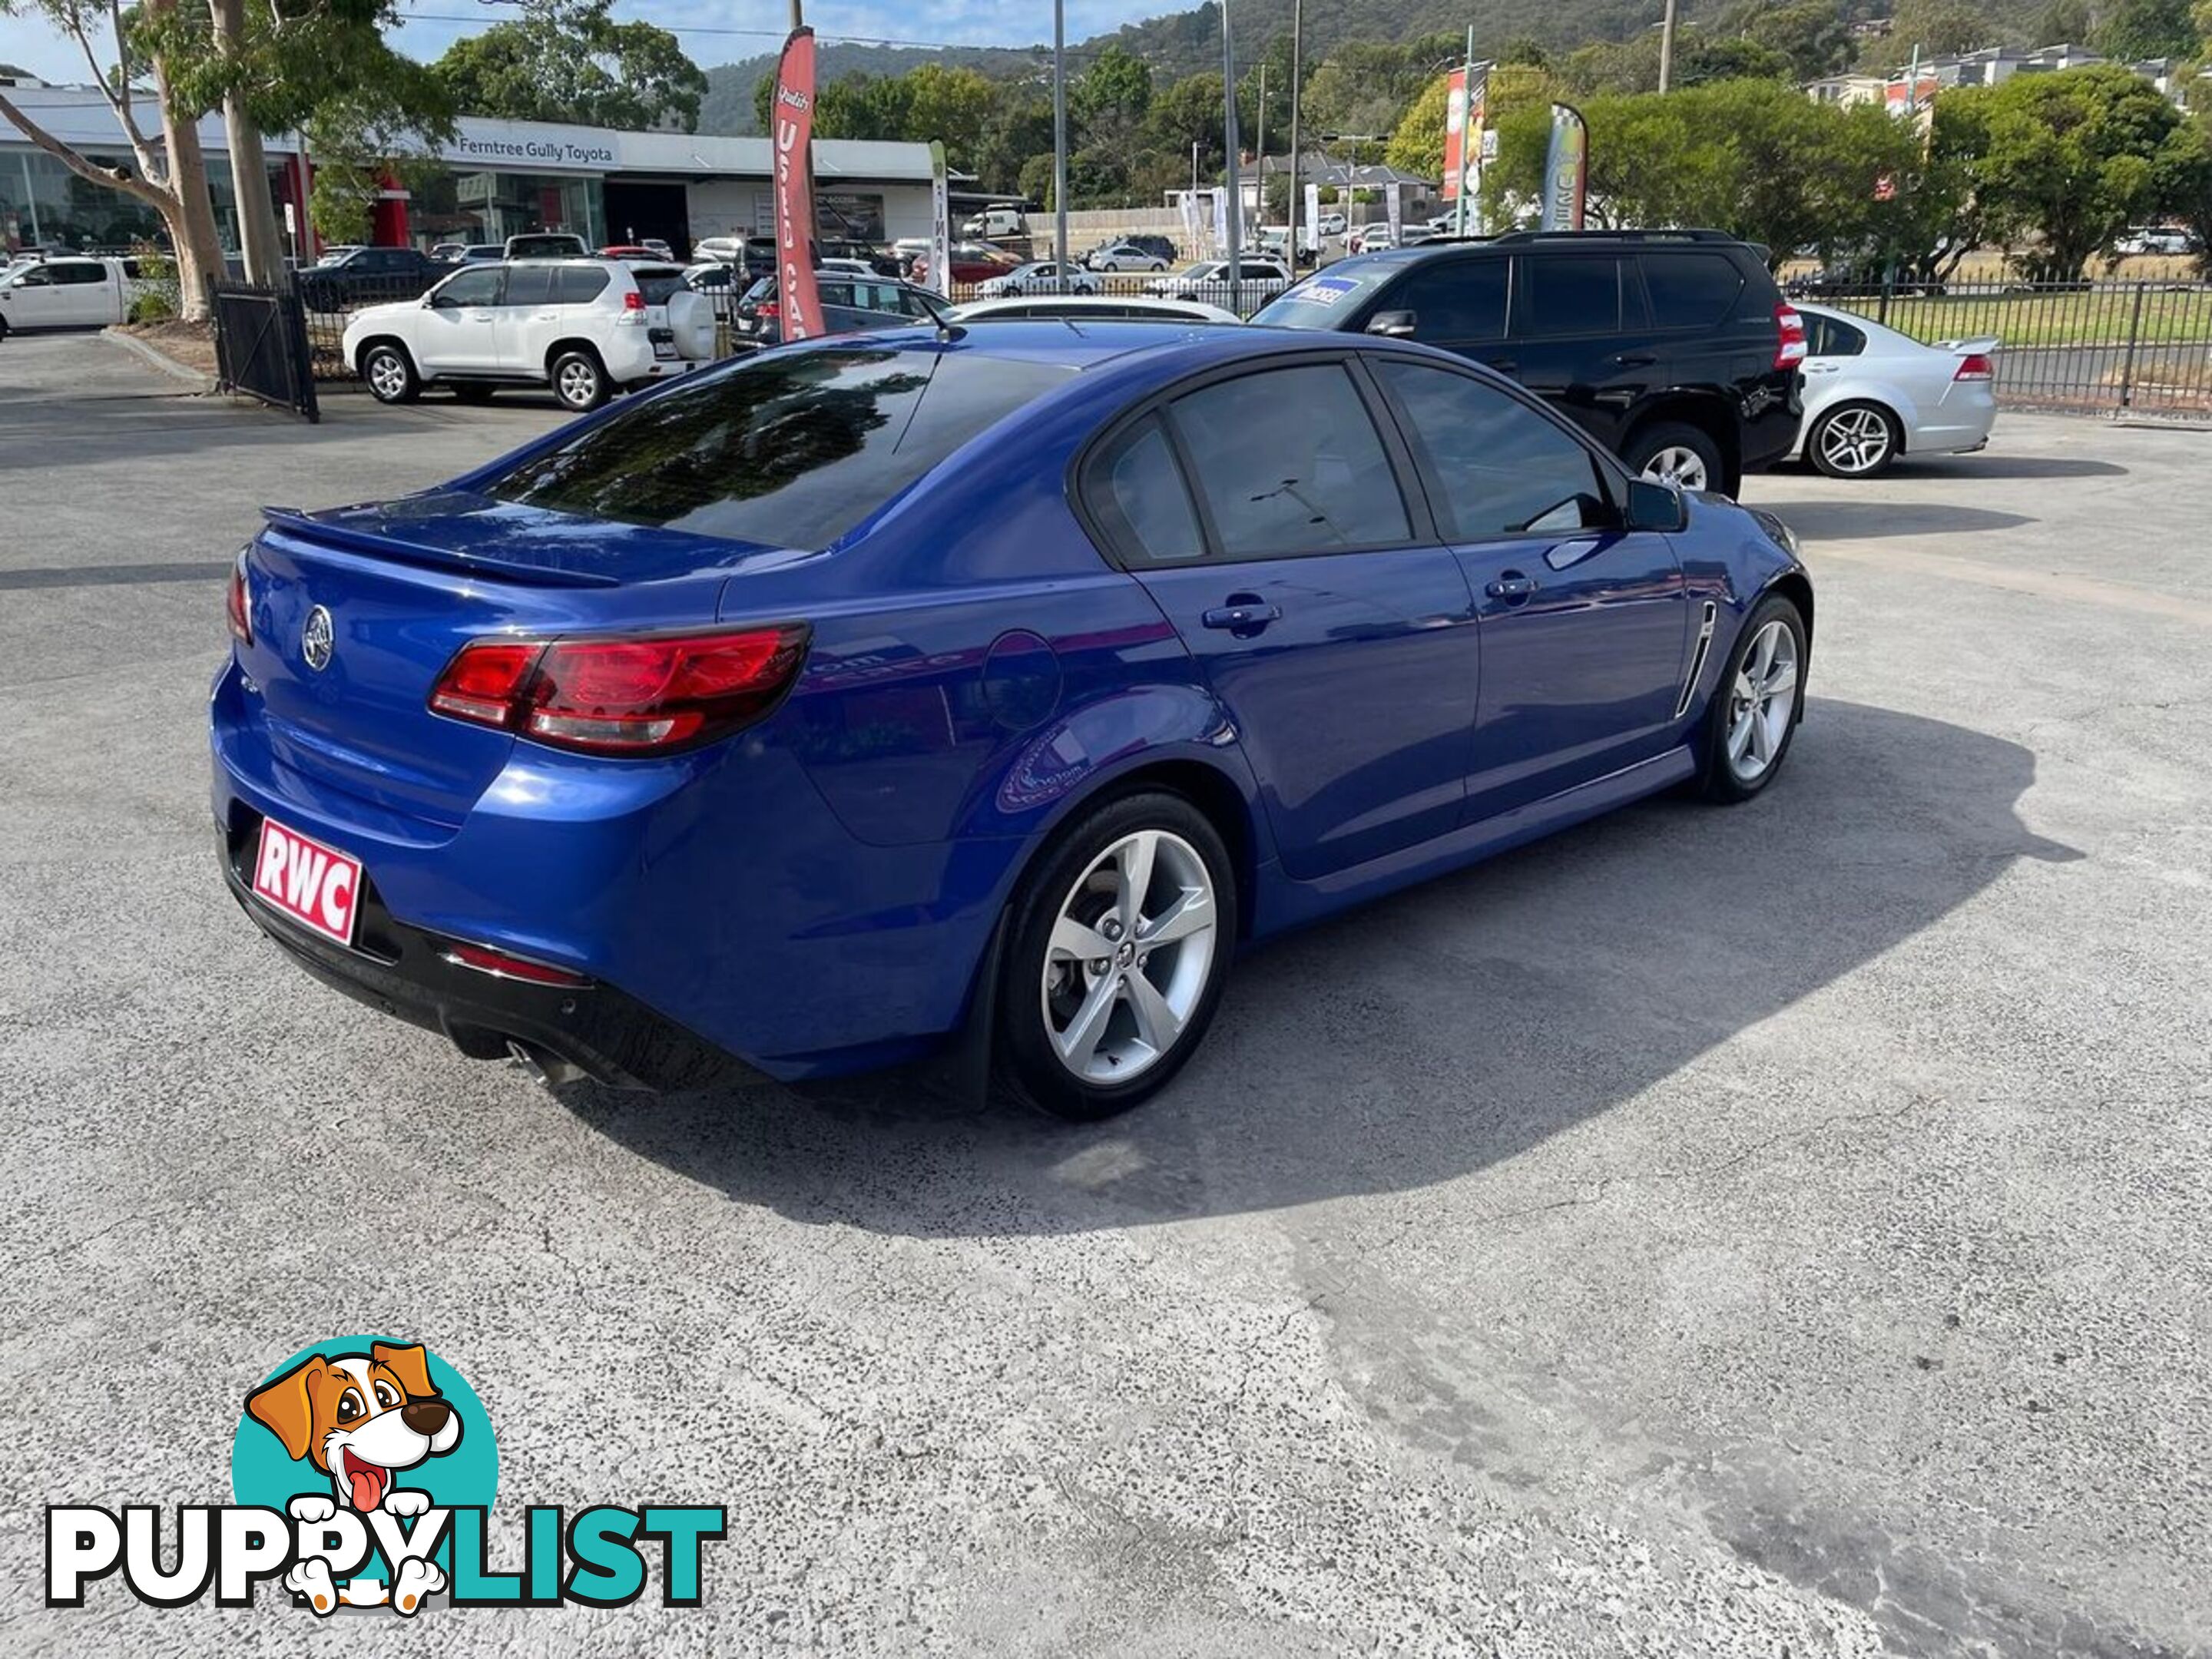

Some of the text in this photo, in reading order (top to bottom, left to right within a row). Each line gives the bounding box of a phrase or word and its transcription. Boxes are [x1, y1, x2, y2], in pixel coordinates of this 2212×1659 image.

[460, 137, 613, 163] Ferntree Gully Toyota
[260, 826, 352, 932] RWC
